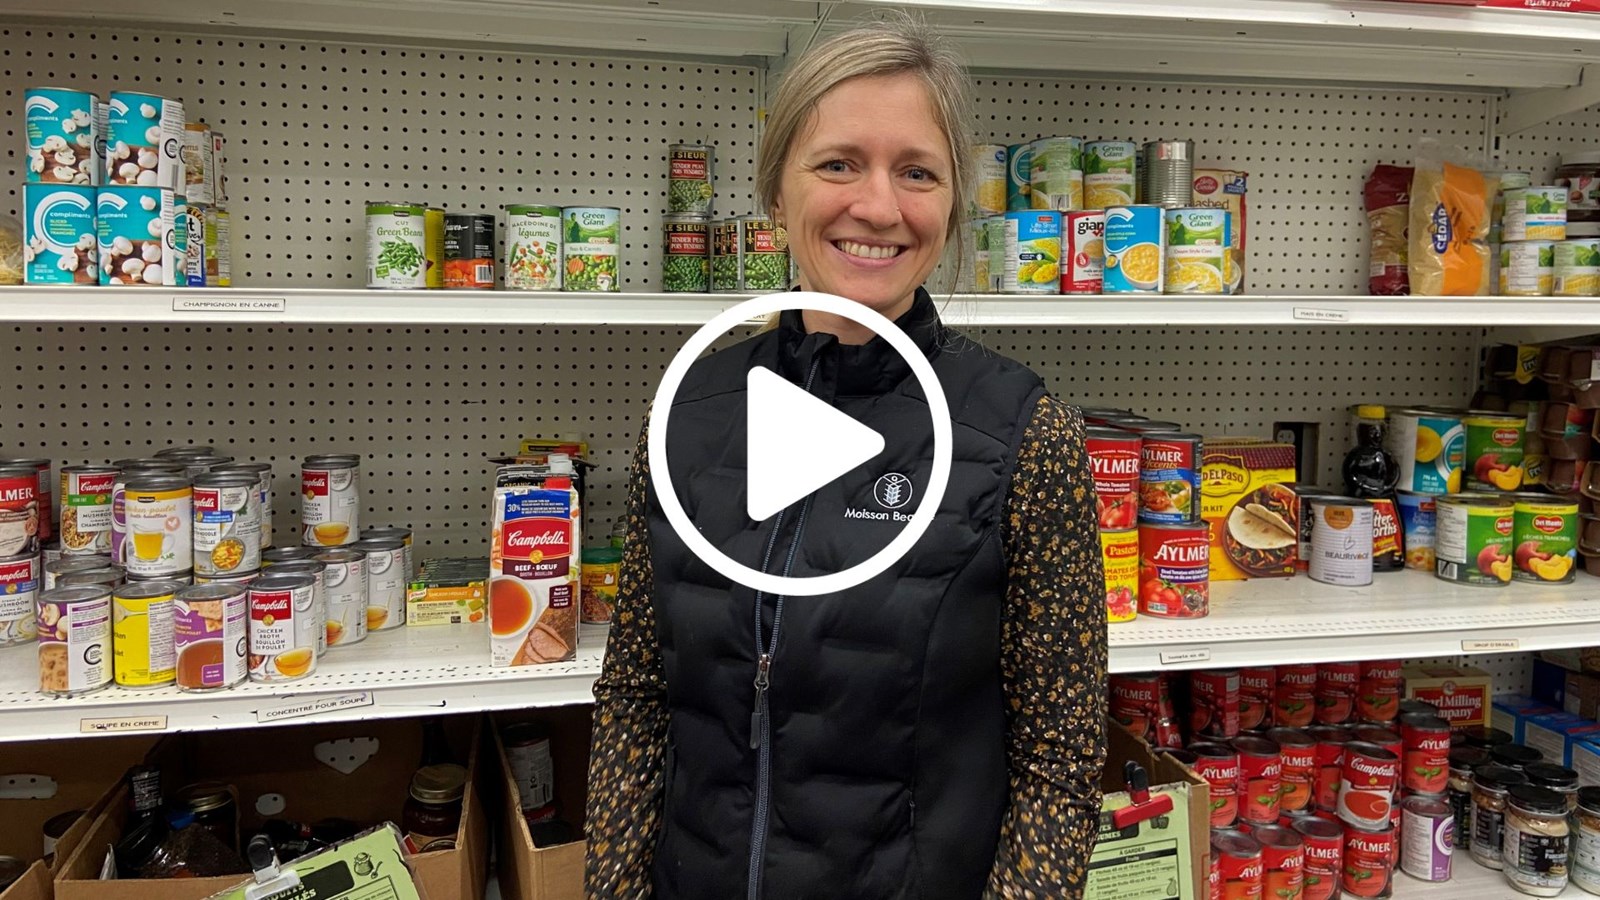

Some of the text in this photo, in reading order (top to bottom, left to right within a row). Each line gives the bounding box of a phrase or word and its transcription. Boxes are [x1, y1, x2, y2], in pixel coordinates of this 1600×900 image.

[678, 151, 706, 159] SIEUR
[1236, 178, 1244, 187] 2
[582, 212, 606, 220] Green
[582, 218, 605, 226] Giant
[1077, 217, 1105, 235] gian
[377, 227, 401, 237] Green
[518, 228, 550, 239] légumes
[664, 224, 706, 232] LE SIEUR
[727, 225, 735, 233] LE
[844, 507, 915, 522] Moisson Bea
[1113, 686, 1152, 700] AYLMER
[266, 697, 366, 717] CONCENTRÉ POUR SOUPE
[1445, 695, 1482, 708] Milling
[1438, 708, 1473, 720] mpany
[1280, 756, 1314, 767] YLMER
[1348, 838, 1391, 852] AYLMER
[1124, 847, 1145, 855] GARDER
[1304, 845, 1339, 858] YLMER
